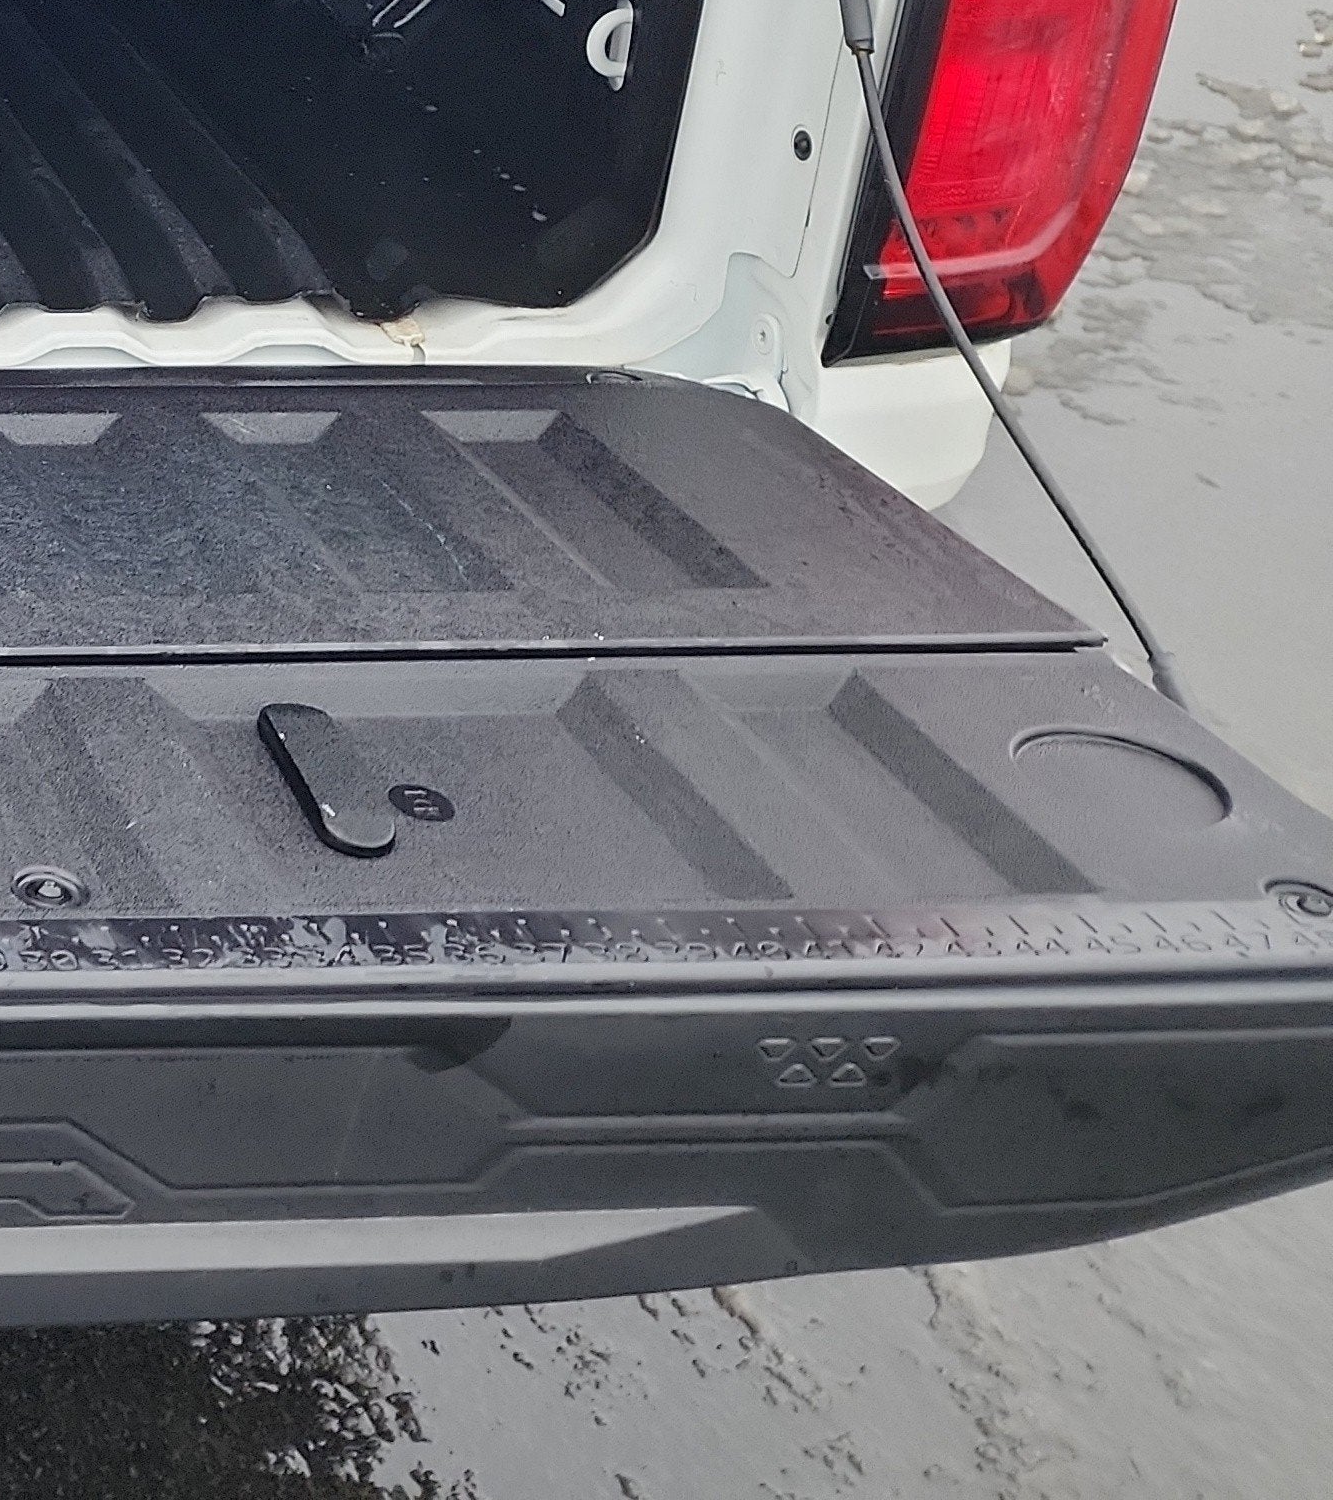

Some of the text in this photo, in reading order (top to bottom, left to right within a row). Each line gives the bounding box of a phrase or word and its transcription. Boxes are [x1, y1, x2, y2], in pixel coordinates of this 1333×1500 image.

[20, 950, 78, 971] 30
[1015, 937, 1071, 956] 44
[1086, 935, 1142, 955] 45
[1155, 934, 1213, 953] 46
[1225, 931, 1272, 951] 47
